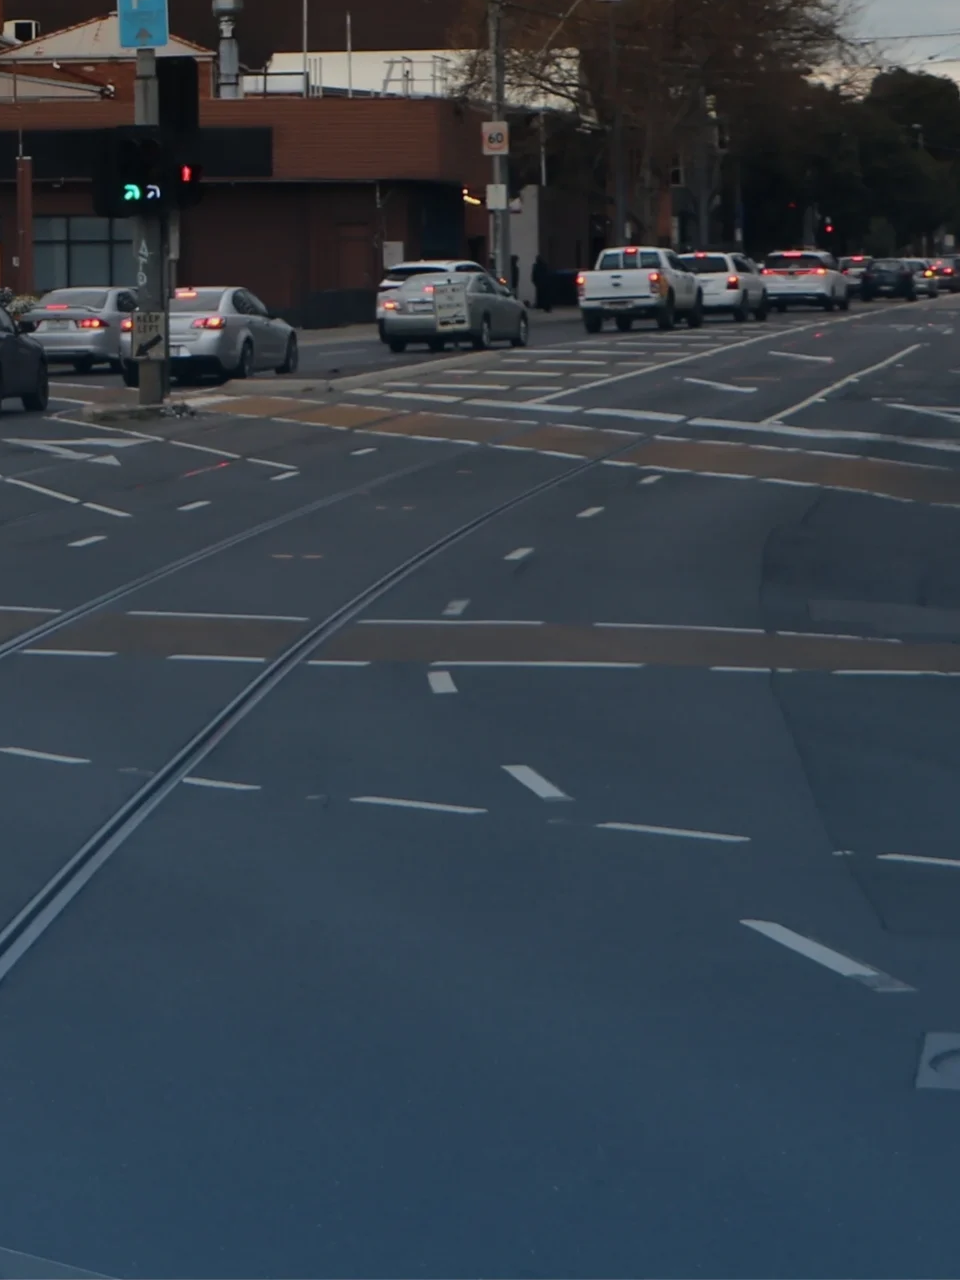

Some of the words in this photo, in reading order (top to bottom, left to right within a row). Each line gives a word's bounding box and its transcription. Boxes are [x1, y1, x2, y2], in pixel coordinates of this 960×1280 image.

[488, 132, 504, 144] 60
[137, 314, 160, 322] KEEP
[137, 324, 159, 333] LEFT
